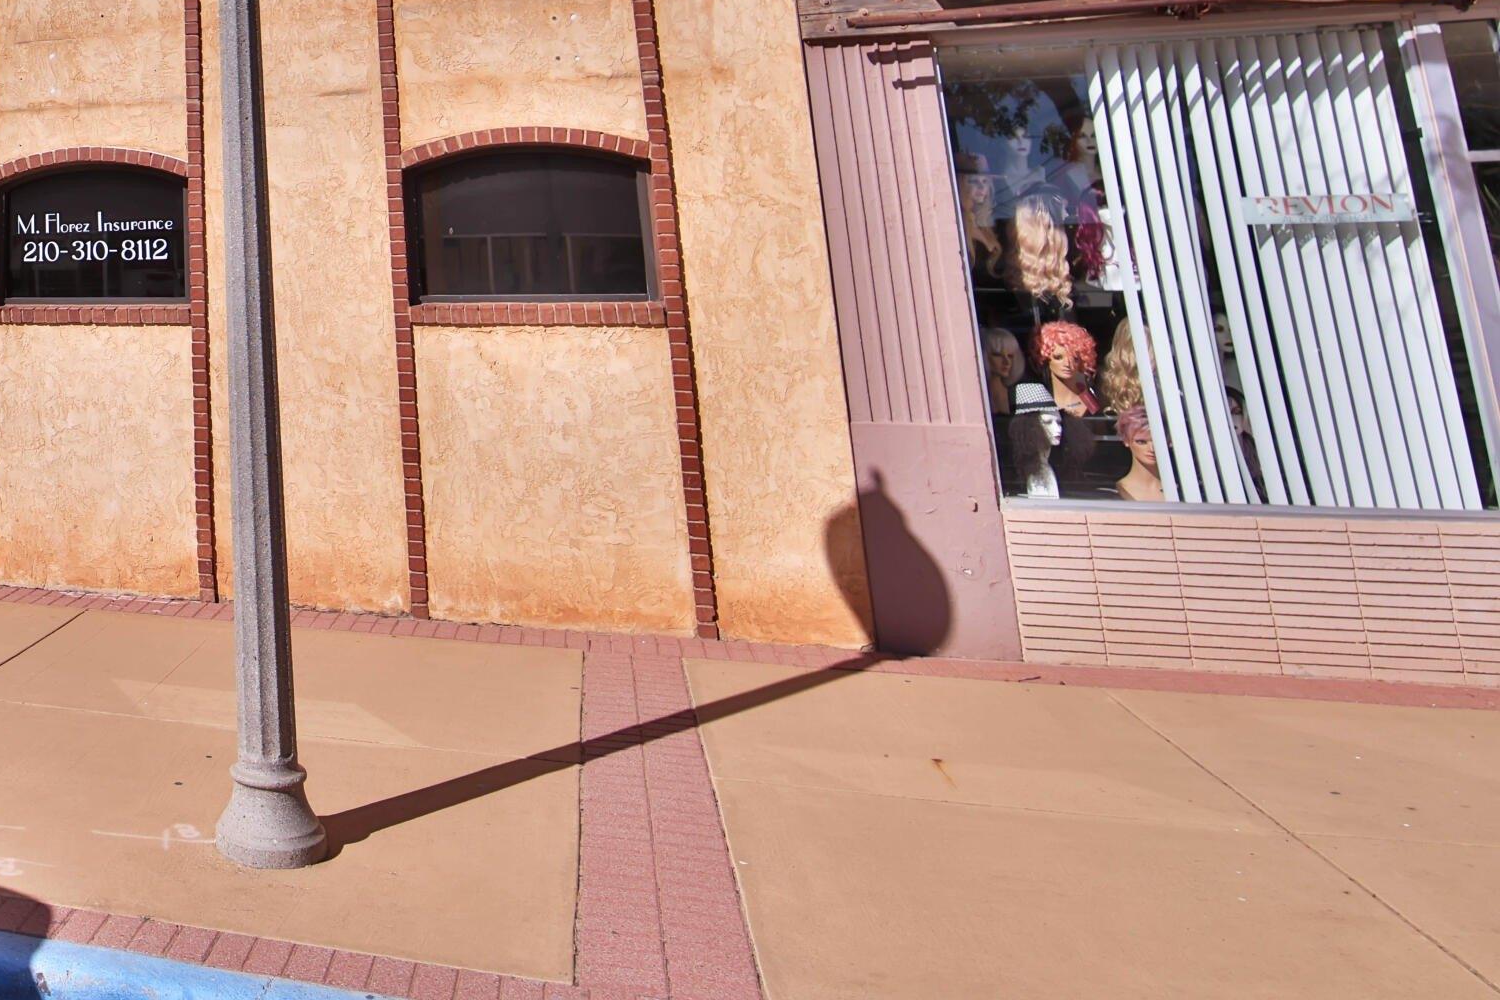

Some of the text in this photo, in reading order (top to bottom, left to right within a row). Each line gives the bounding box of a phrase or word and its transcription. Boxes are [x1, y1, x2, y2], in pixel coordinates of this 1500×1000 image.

[1255, 194, 1395, 216] REVLON
[17, 211, 173, 235] M. Florez Insurance
[23, 239, 169, 262] 210-310-8112
